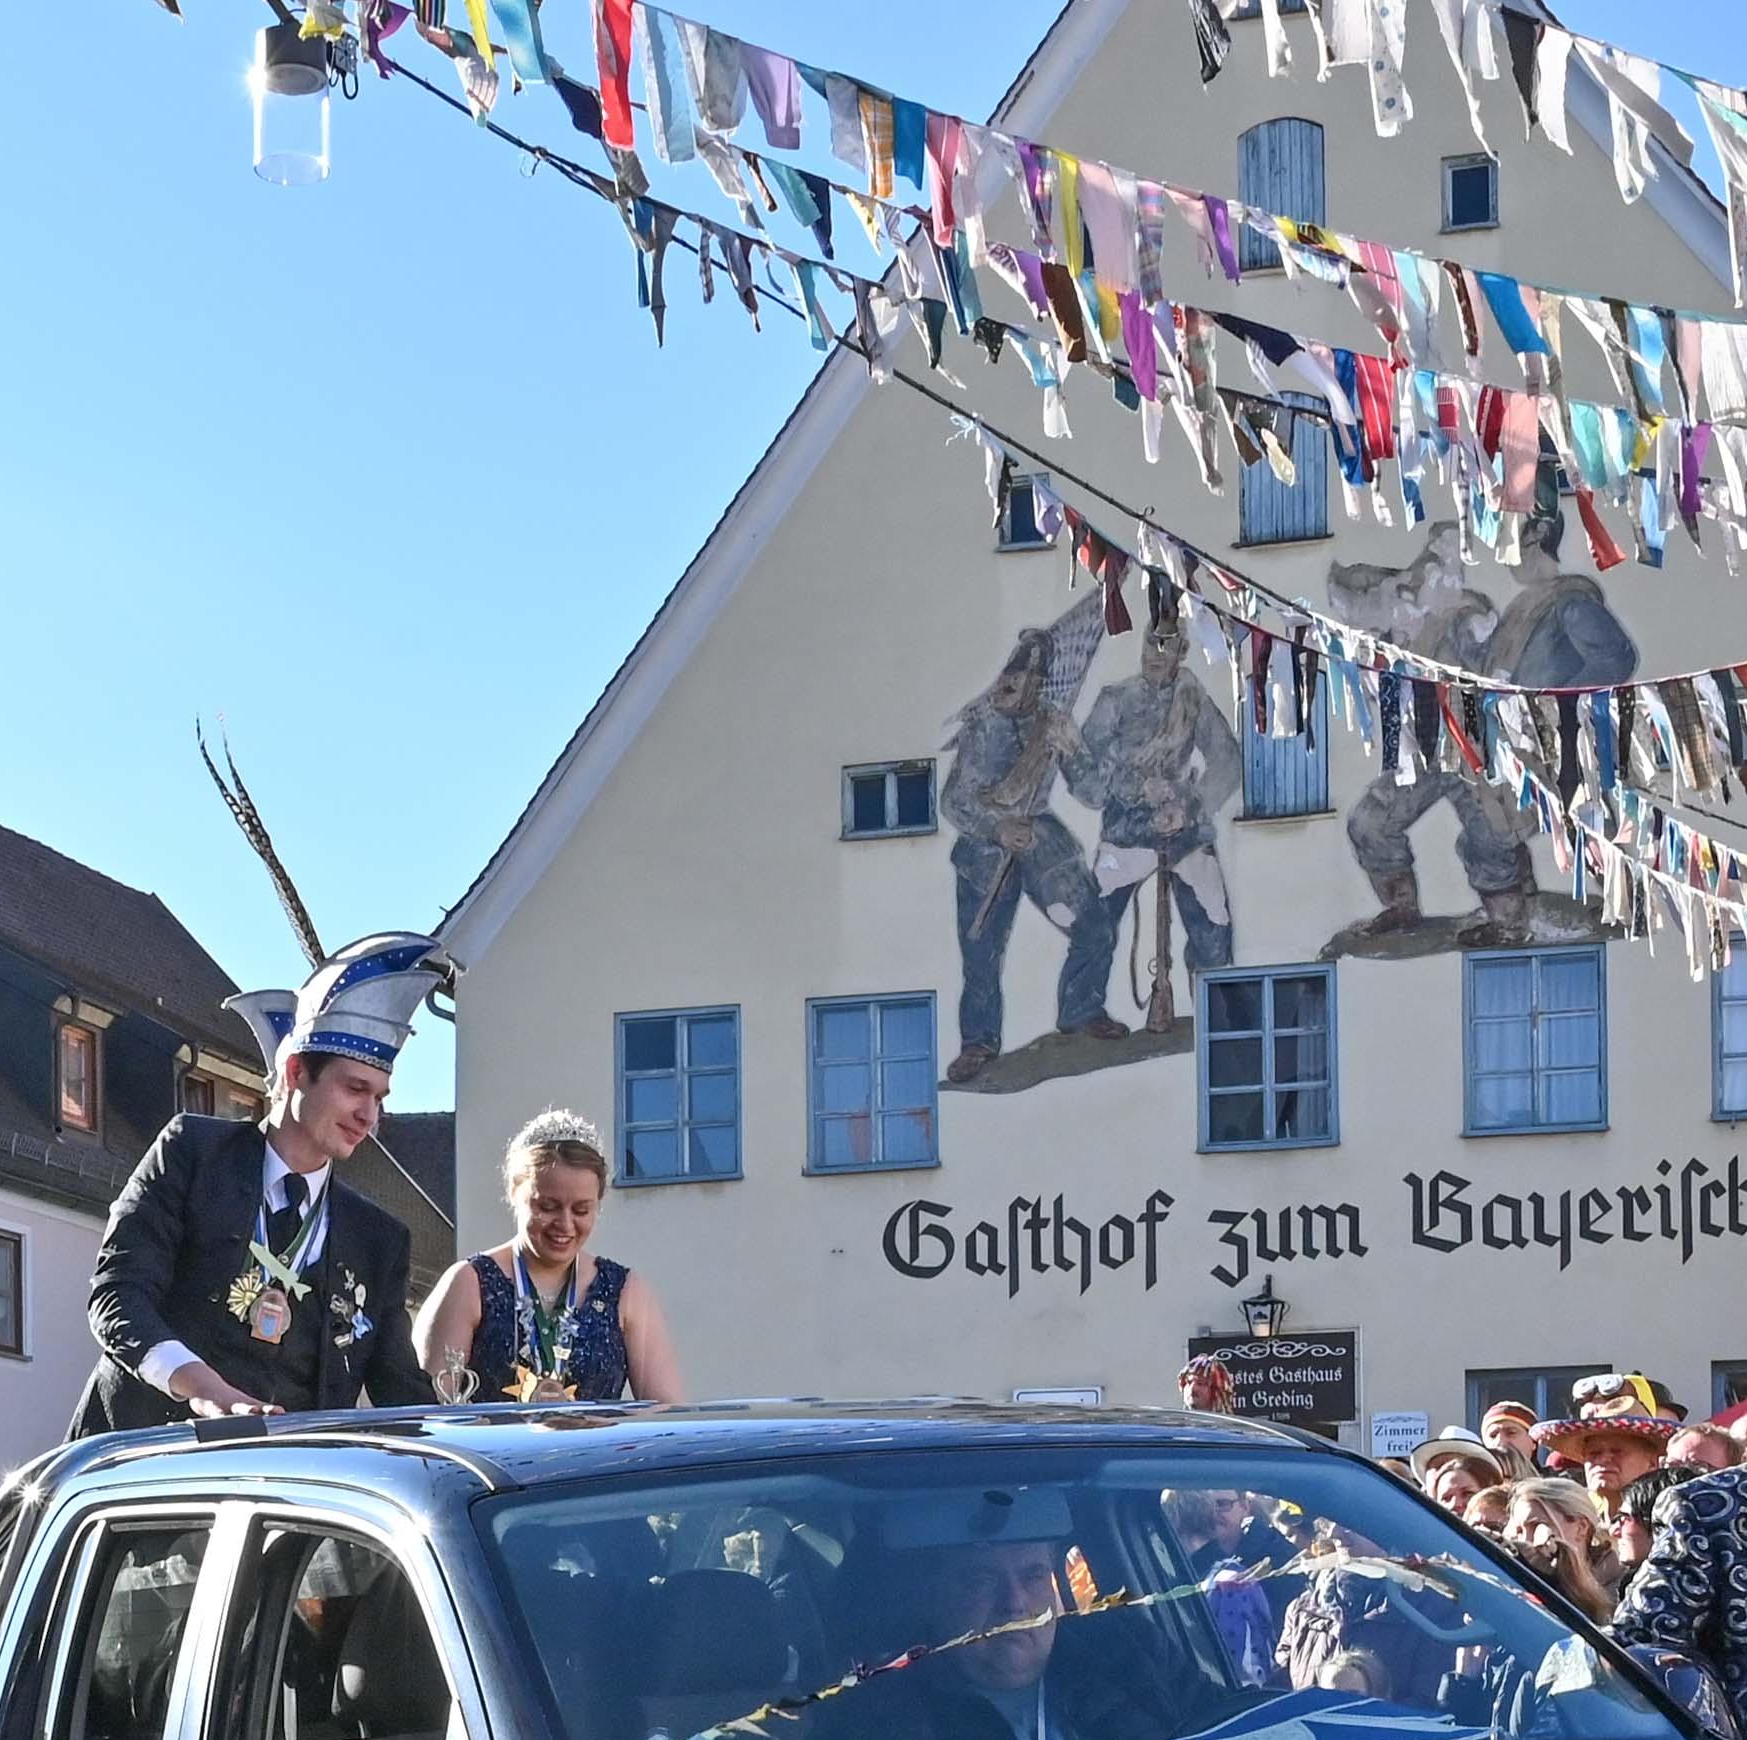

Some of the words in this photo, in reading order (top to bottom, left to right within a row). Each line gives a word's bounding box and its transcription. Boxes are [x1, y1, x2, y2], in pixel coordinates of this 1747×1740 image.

[1206, 1200, 1370, 1288] zum
[1268, 1366, 1343, 1386] Gasthaus
[1252, 1389, 1314, 1410] Greding
[1373, 1424, 1426, 1437] Zimmer
